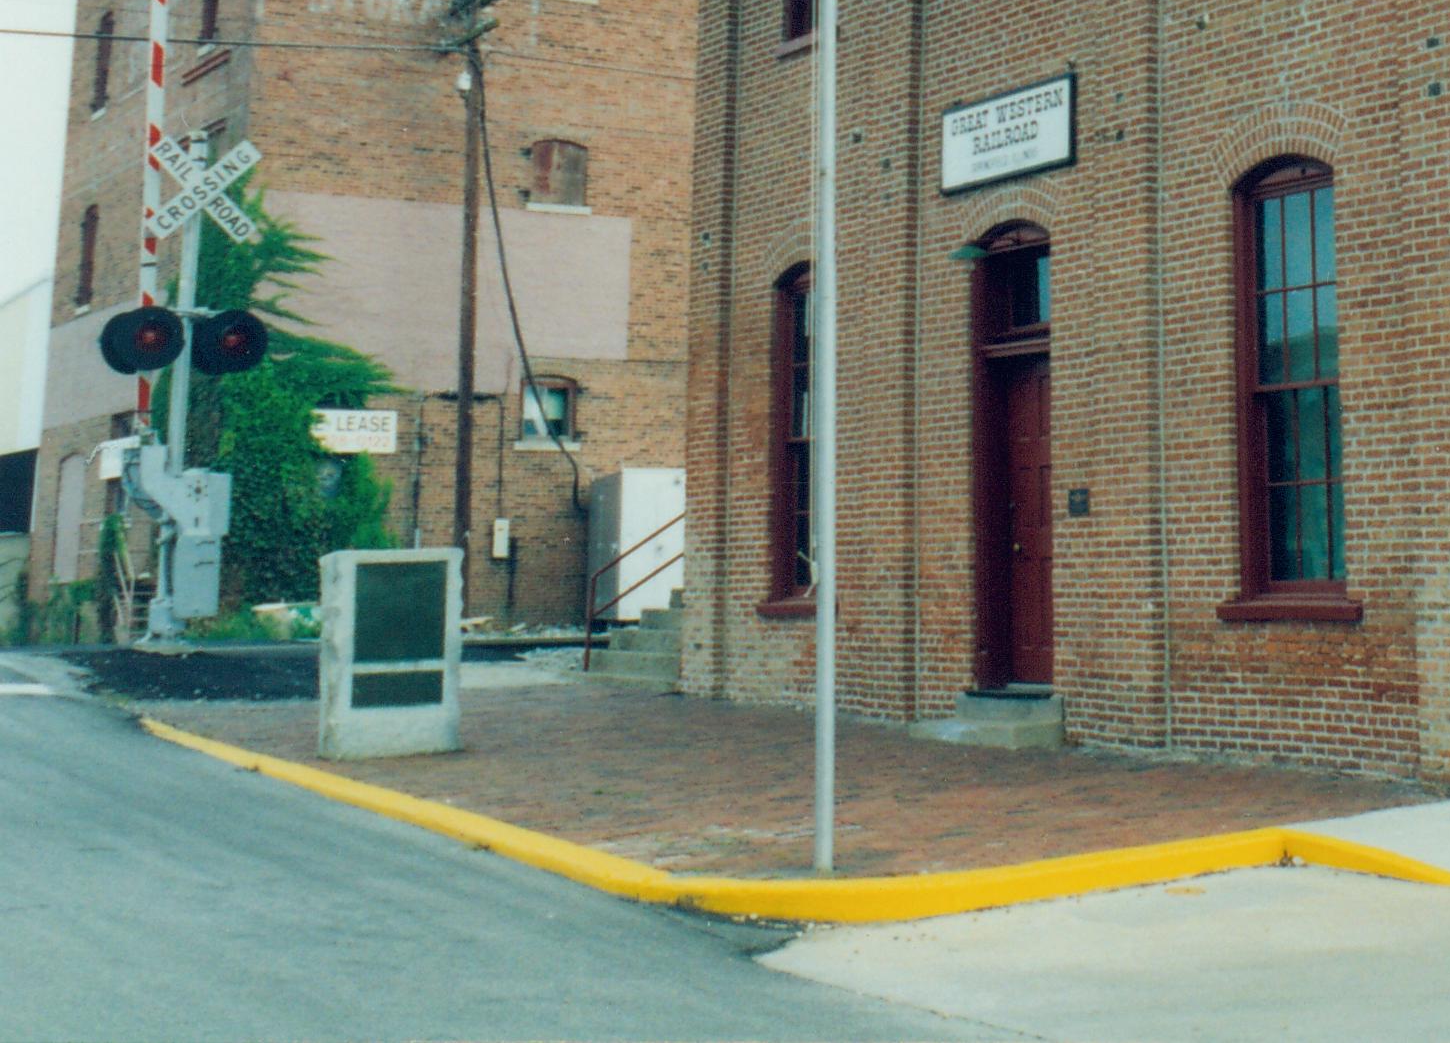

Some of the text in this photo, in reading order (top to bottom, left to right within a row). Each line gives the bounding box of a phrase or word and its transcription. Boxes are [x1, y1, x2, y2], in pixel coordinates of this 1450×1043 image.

[951, 88, 1064, 137] GREAT WESTERN
[972, 120, 1039, 155] RAILROAD
[156, 141, 250, 237] RAIL ROAD
[156, 150, 251, 230] CROSSING
[336, 414, 392, 433] LEASE
